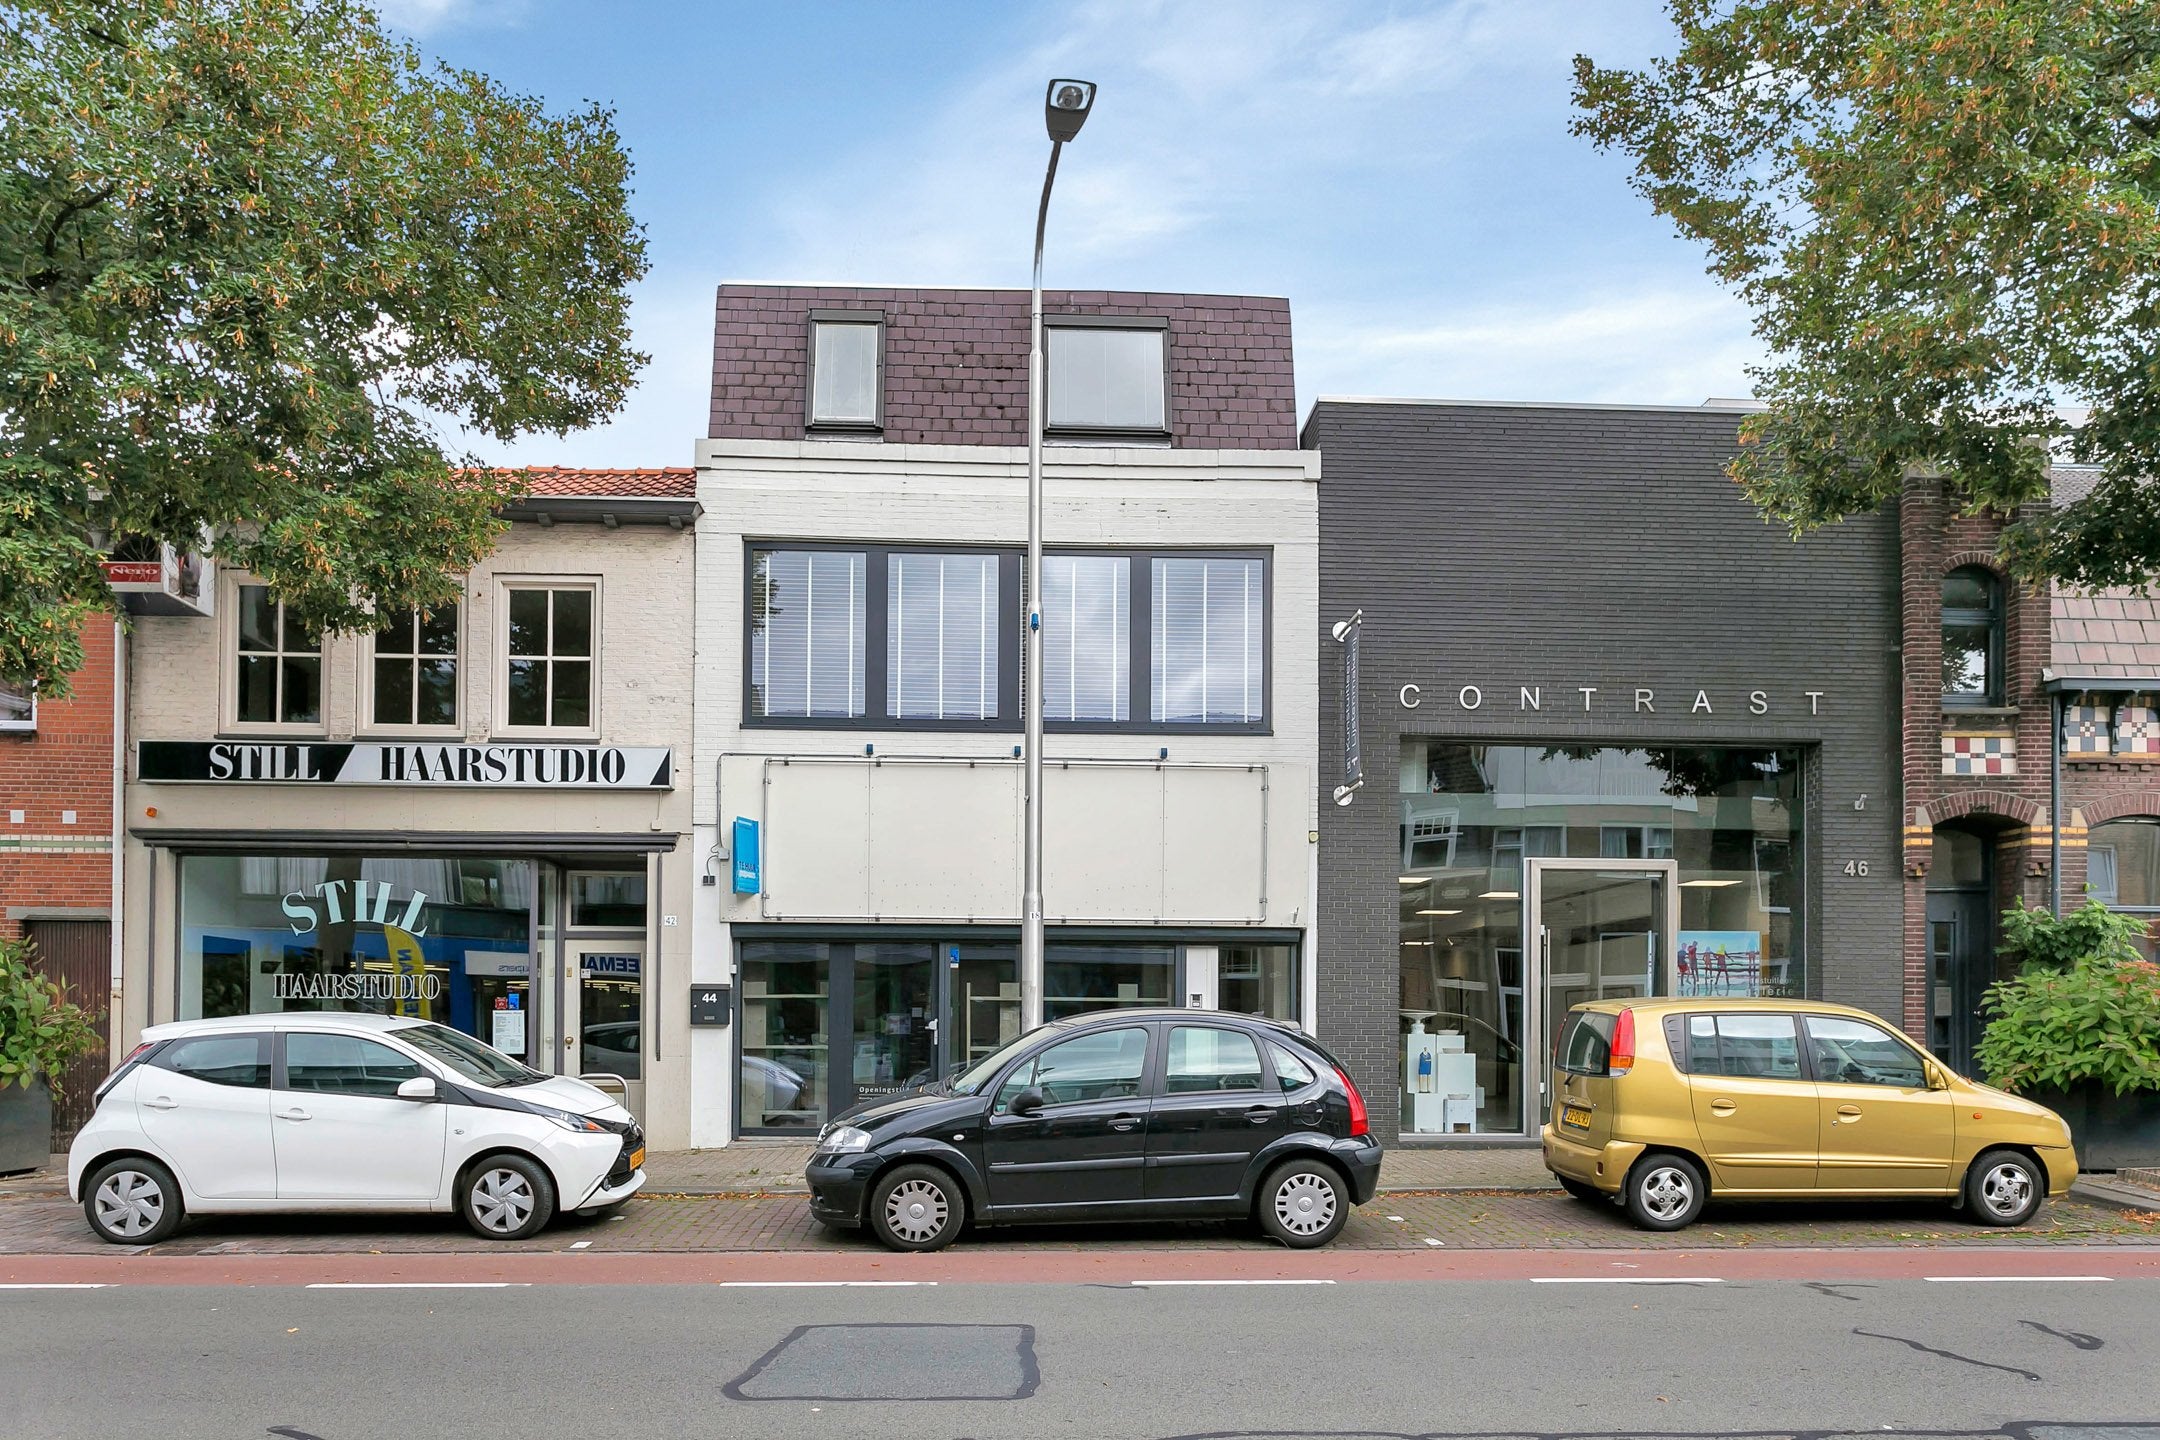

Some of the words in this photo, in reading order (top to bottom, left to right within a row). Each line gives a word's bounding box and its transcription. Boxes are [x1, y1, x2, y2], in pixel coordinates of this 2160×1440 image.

[1400, 684, 1823, 715] CONTRAST
[209, 744, 320, 780] STILL
[379, 746, 626, 784] HAARSTUDIO
[1844, 860, 1868, 877] 46
[281, 880, 429, 937] STILL
[665, 916, 676, 925] 42
[273, 973, 441, 999] HAARSTUDIO
[701, 993, 718, 1003] 44
